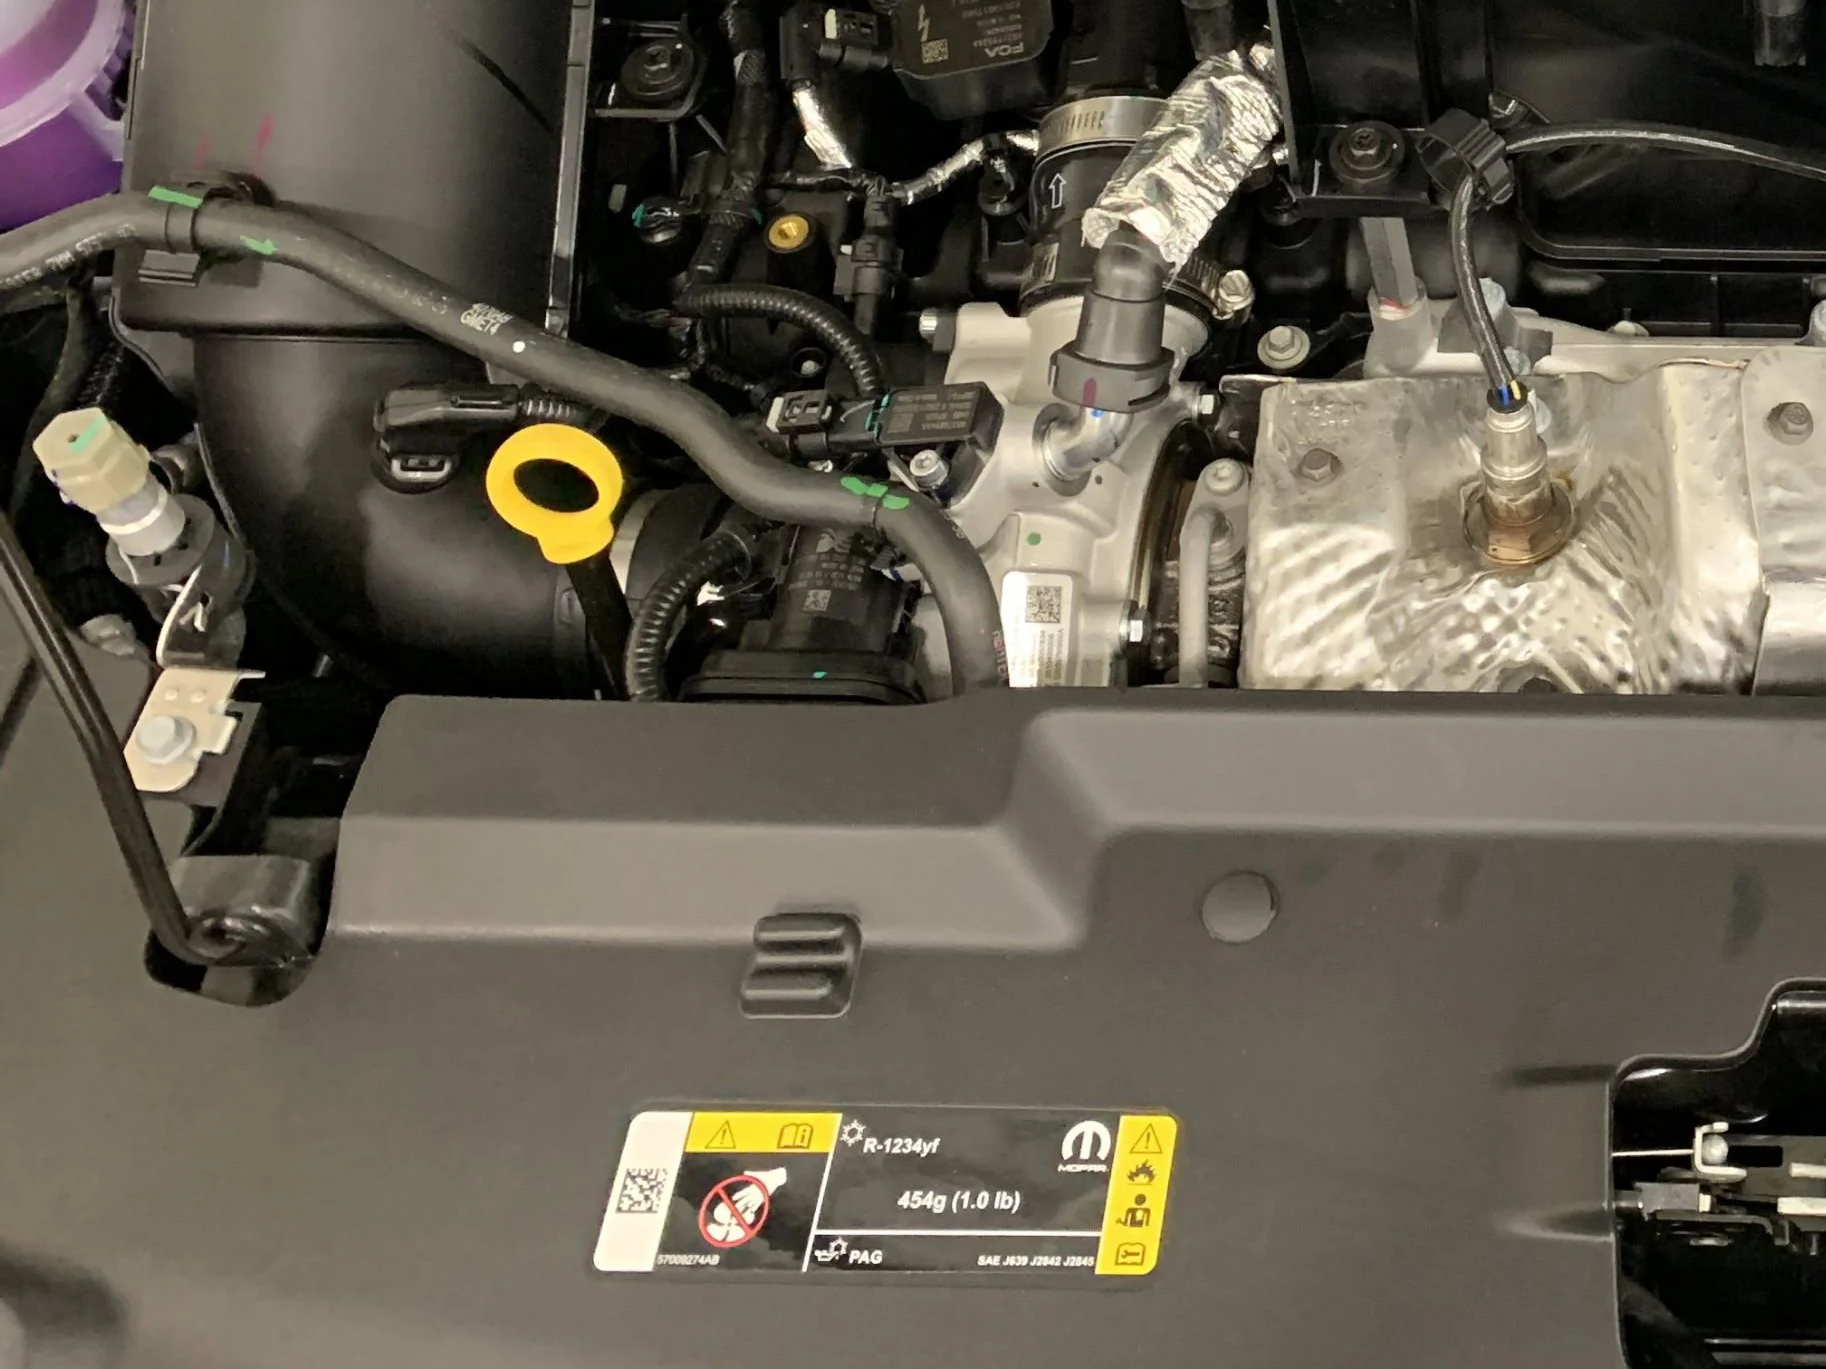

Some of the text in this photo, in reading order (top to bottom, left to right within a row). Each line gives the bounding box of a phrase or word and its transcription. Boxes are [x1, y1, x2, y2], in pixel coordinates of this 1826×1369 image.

[863, 1136, 940, 1156] R-1234yf
[1057, 1164, 1107, 1173] MOPAR
[897, 1190, 1021, 1213] 454g (1.0 lb)
[849, 1248, 883, 1265] PAG
[976, 1254, 1001, 1266] SAE
[1002, 1255, 1029, 1266] J639
